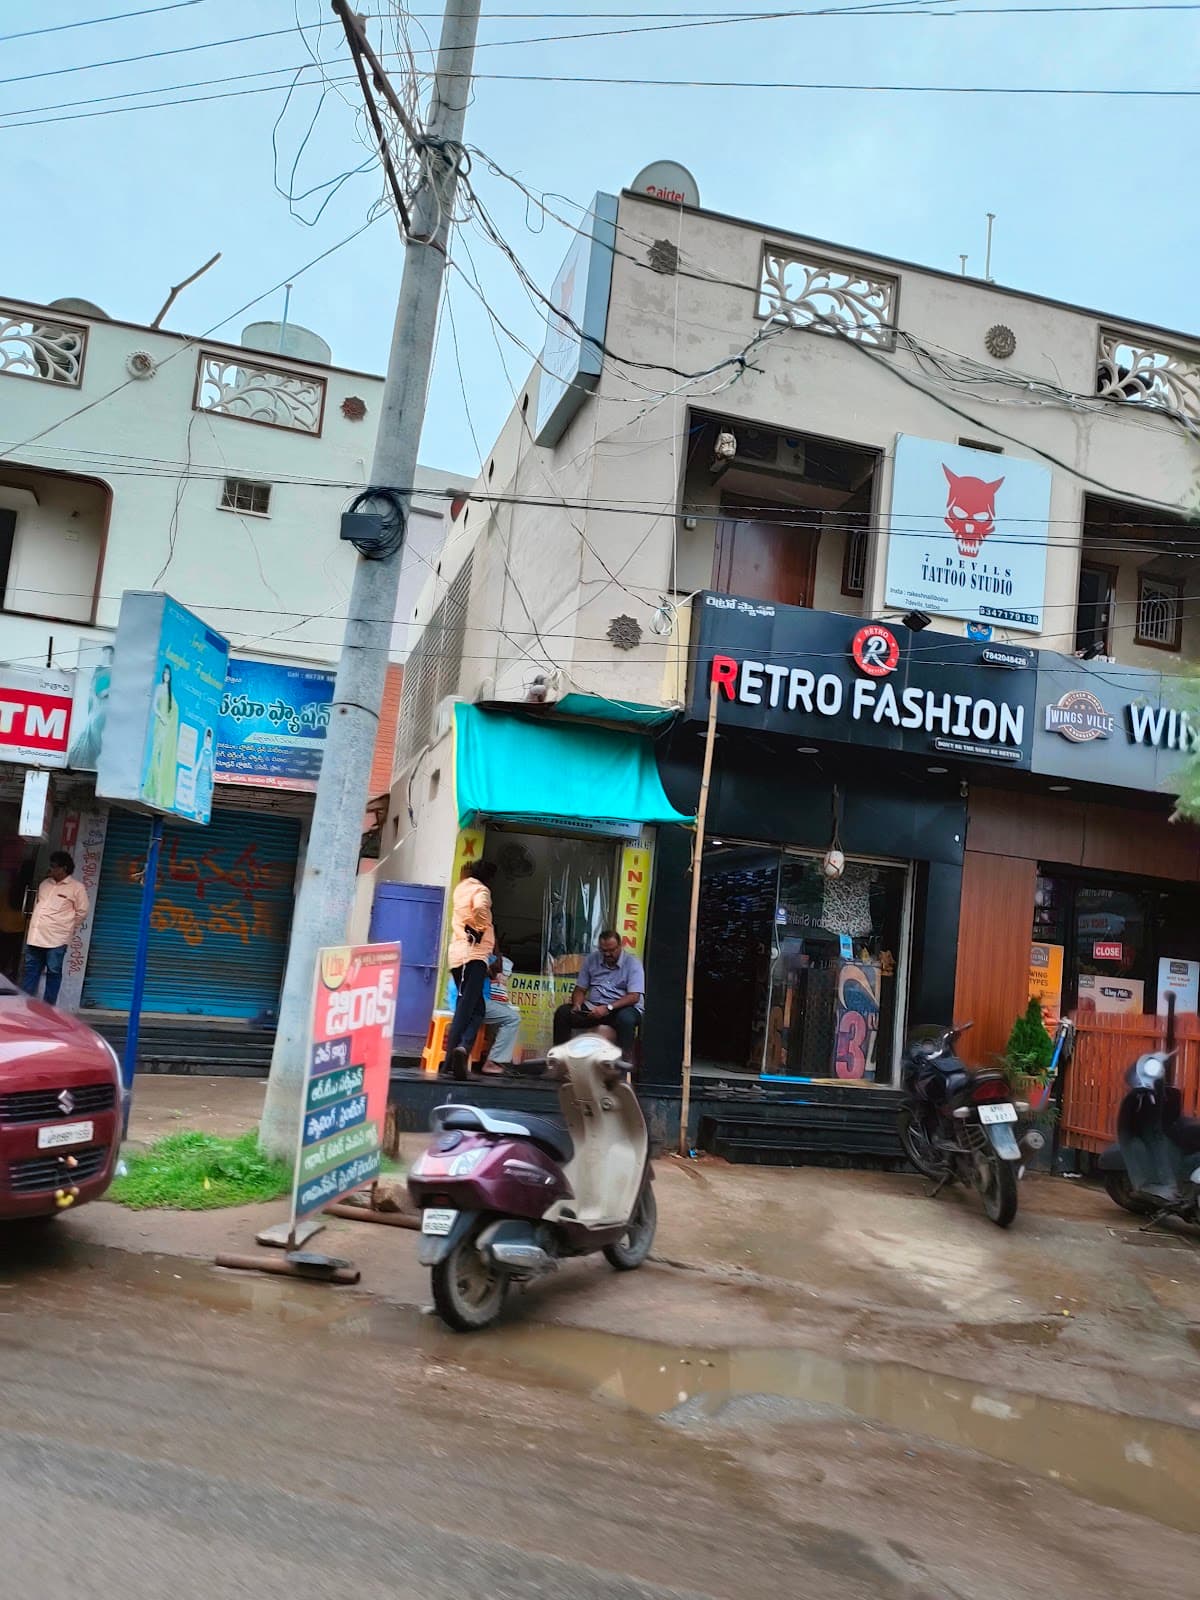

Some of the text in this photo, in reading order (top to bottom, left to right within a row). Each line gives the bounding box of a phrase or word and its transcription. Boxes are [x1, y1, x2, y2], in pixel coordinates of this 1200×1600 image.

[656, 187, 685, 202] airtel
[925, 554, 1013, 577] 7 DEVILS
[921, 565, 1013, 597] TATTOO STUDIO
[863, 627, 889, 638] RETRO
[711, 654, 1025, 746] RETRO FASHION
[1050, 710, 1114, 732] WINGS VILLE
[1096, 947, 1120, 956] CLOSE
